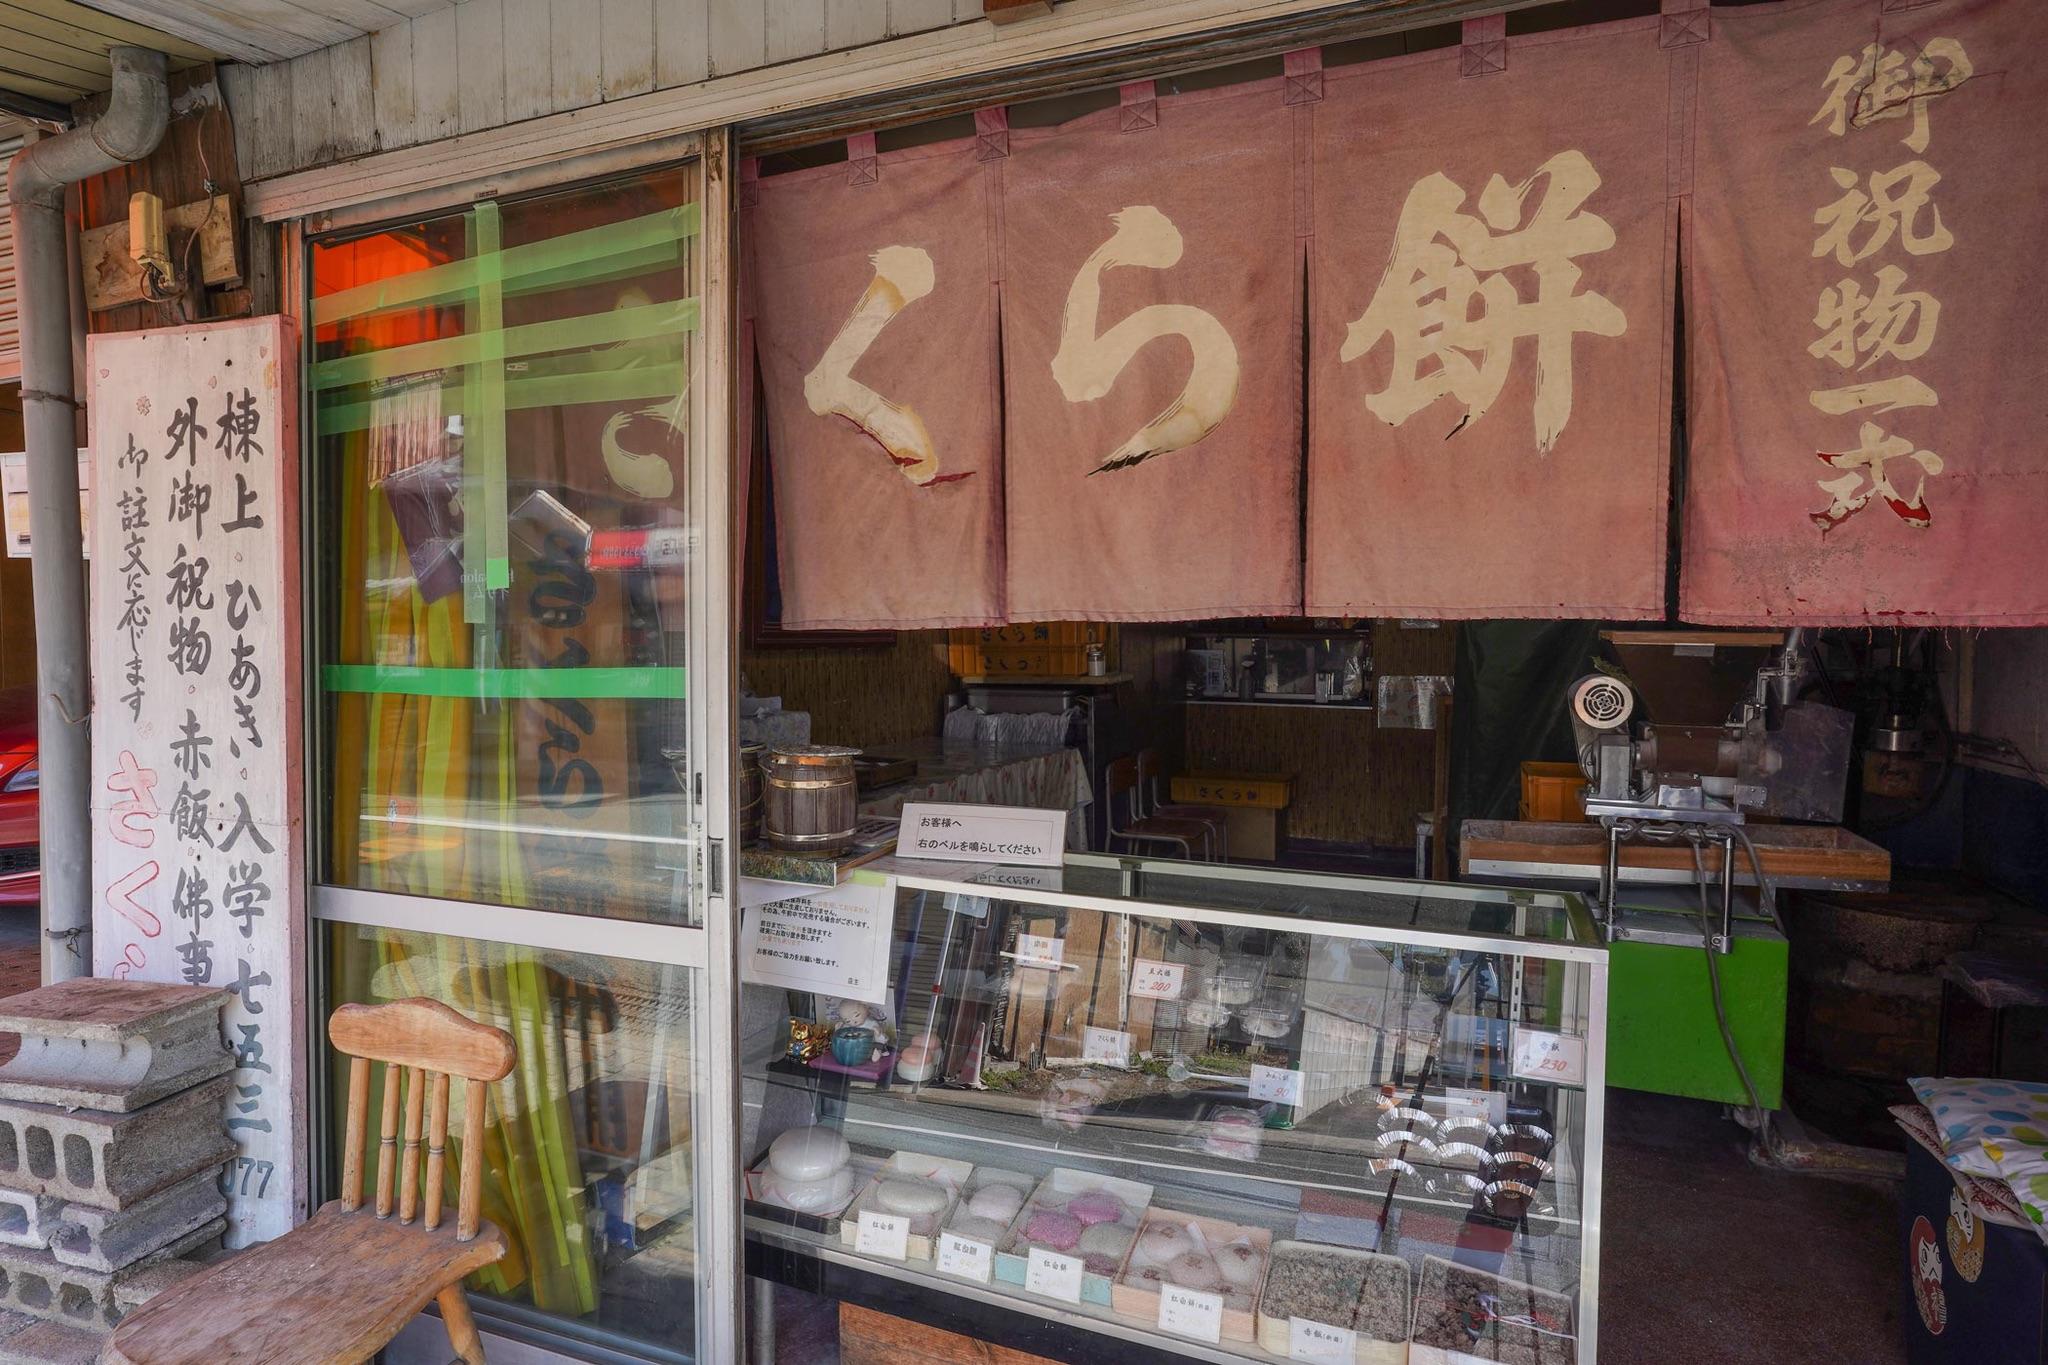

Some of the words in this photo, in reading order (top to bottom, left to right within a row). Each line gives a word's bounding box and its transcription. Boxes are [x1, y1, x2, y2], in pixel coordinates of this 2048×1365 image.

[1807, 36, 1974, 533] 御祝物一式
[920, 817, 962, 828] お客様へ
